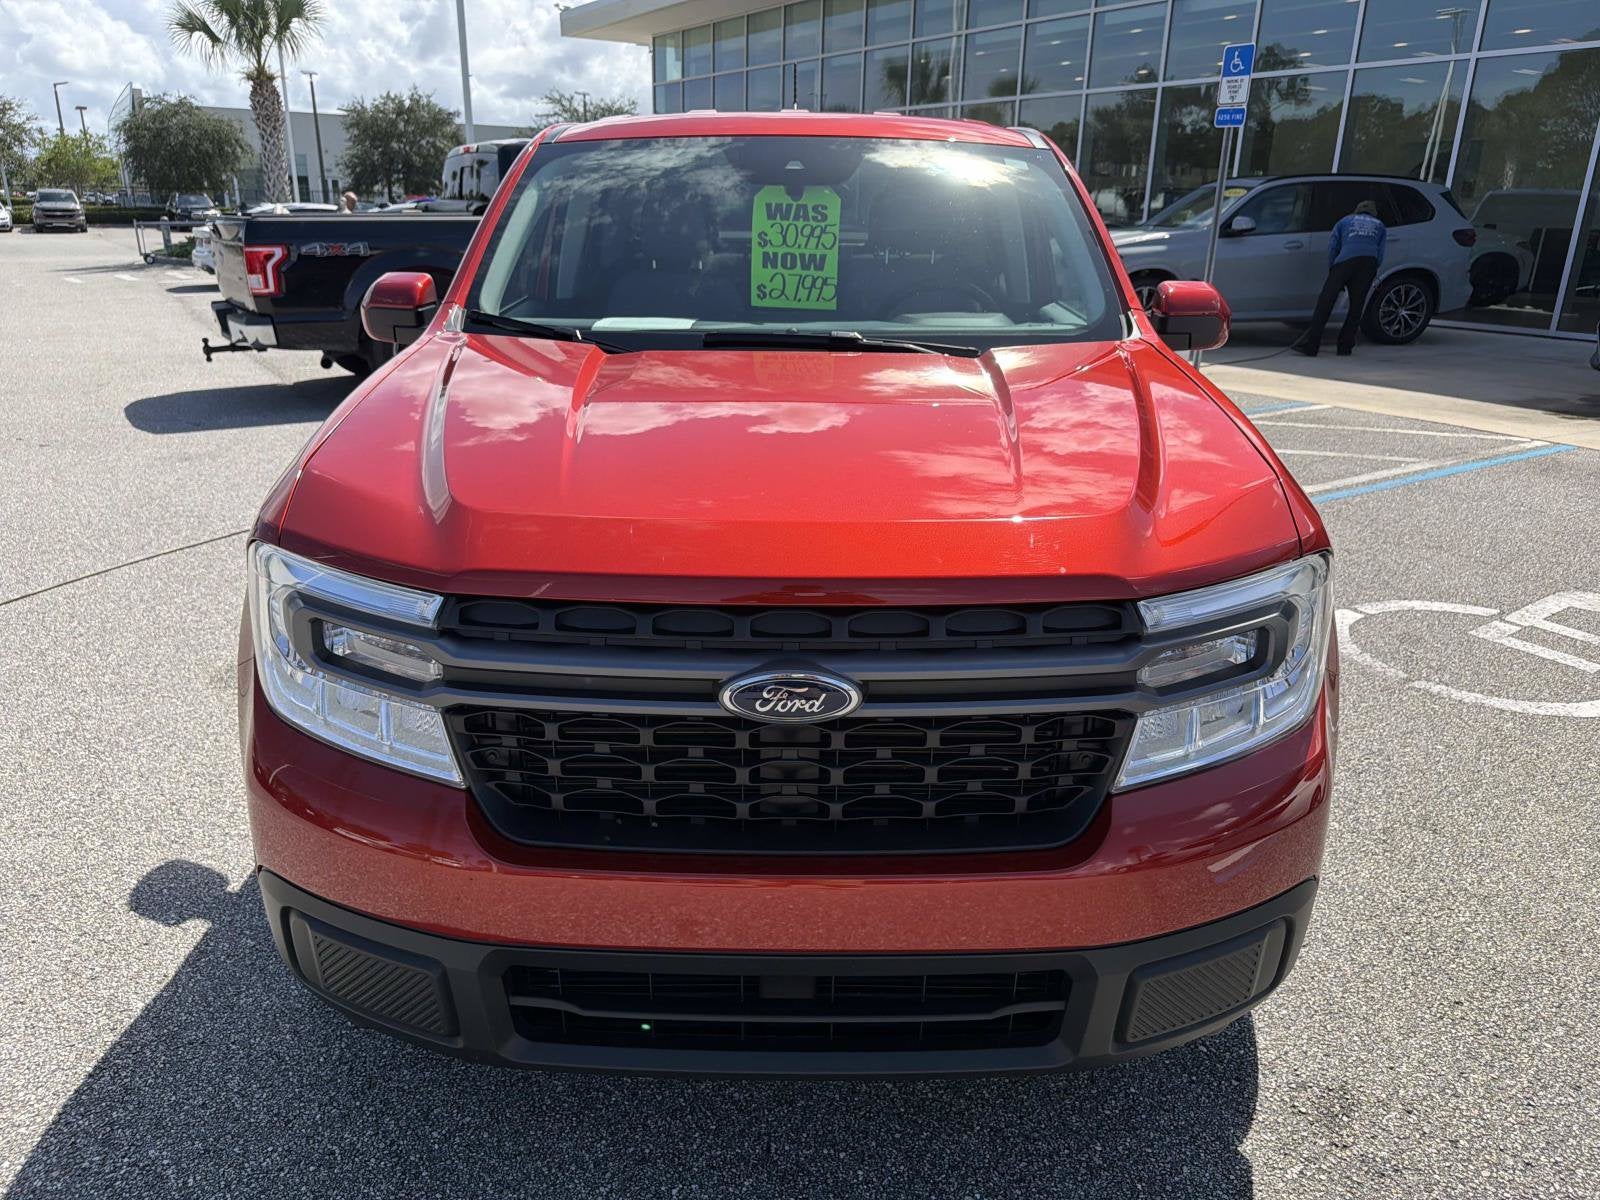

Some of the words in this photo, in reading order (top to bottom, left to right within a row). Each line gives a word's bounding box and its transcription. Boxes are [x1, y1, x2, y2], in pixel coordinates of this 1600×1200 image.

[765, 202, 828, 223] WAS
[762, 251, 828, 272] NOW
[755, 685, 827, 713] Ford
